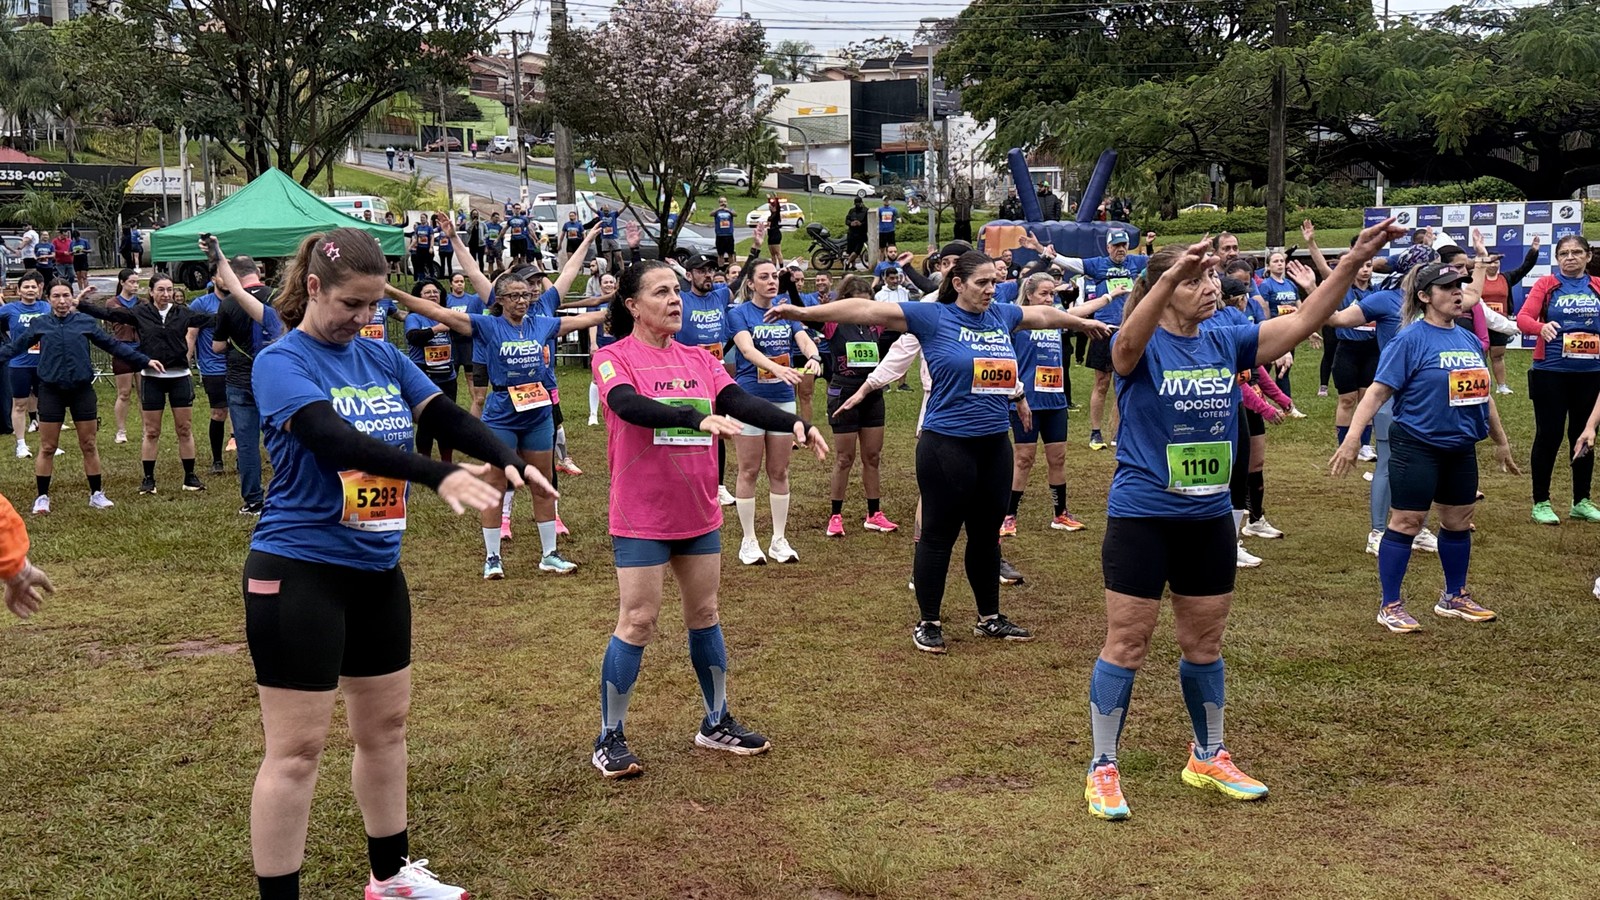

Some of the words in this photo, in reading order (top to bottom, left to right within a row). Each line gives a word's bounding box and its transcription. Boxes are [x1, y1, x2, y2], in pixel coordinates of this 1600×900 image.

[499, 343, 544, 356] MASSA
[1570, 340, 1596, 349] 5200
[853, 349, 874, 358] 1033
[981, 369, 1012, 381] 0050
[1457, 379, 1487, 392] 5244
[1182, 458, 1220, 476] 1110
[357, 486, 398, 508] 5293
